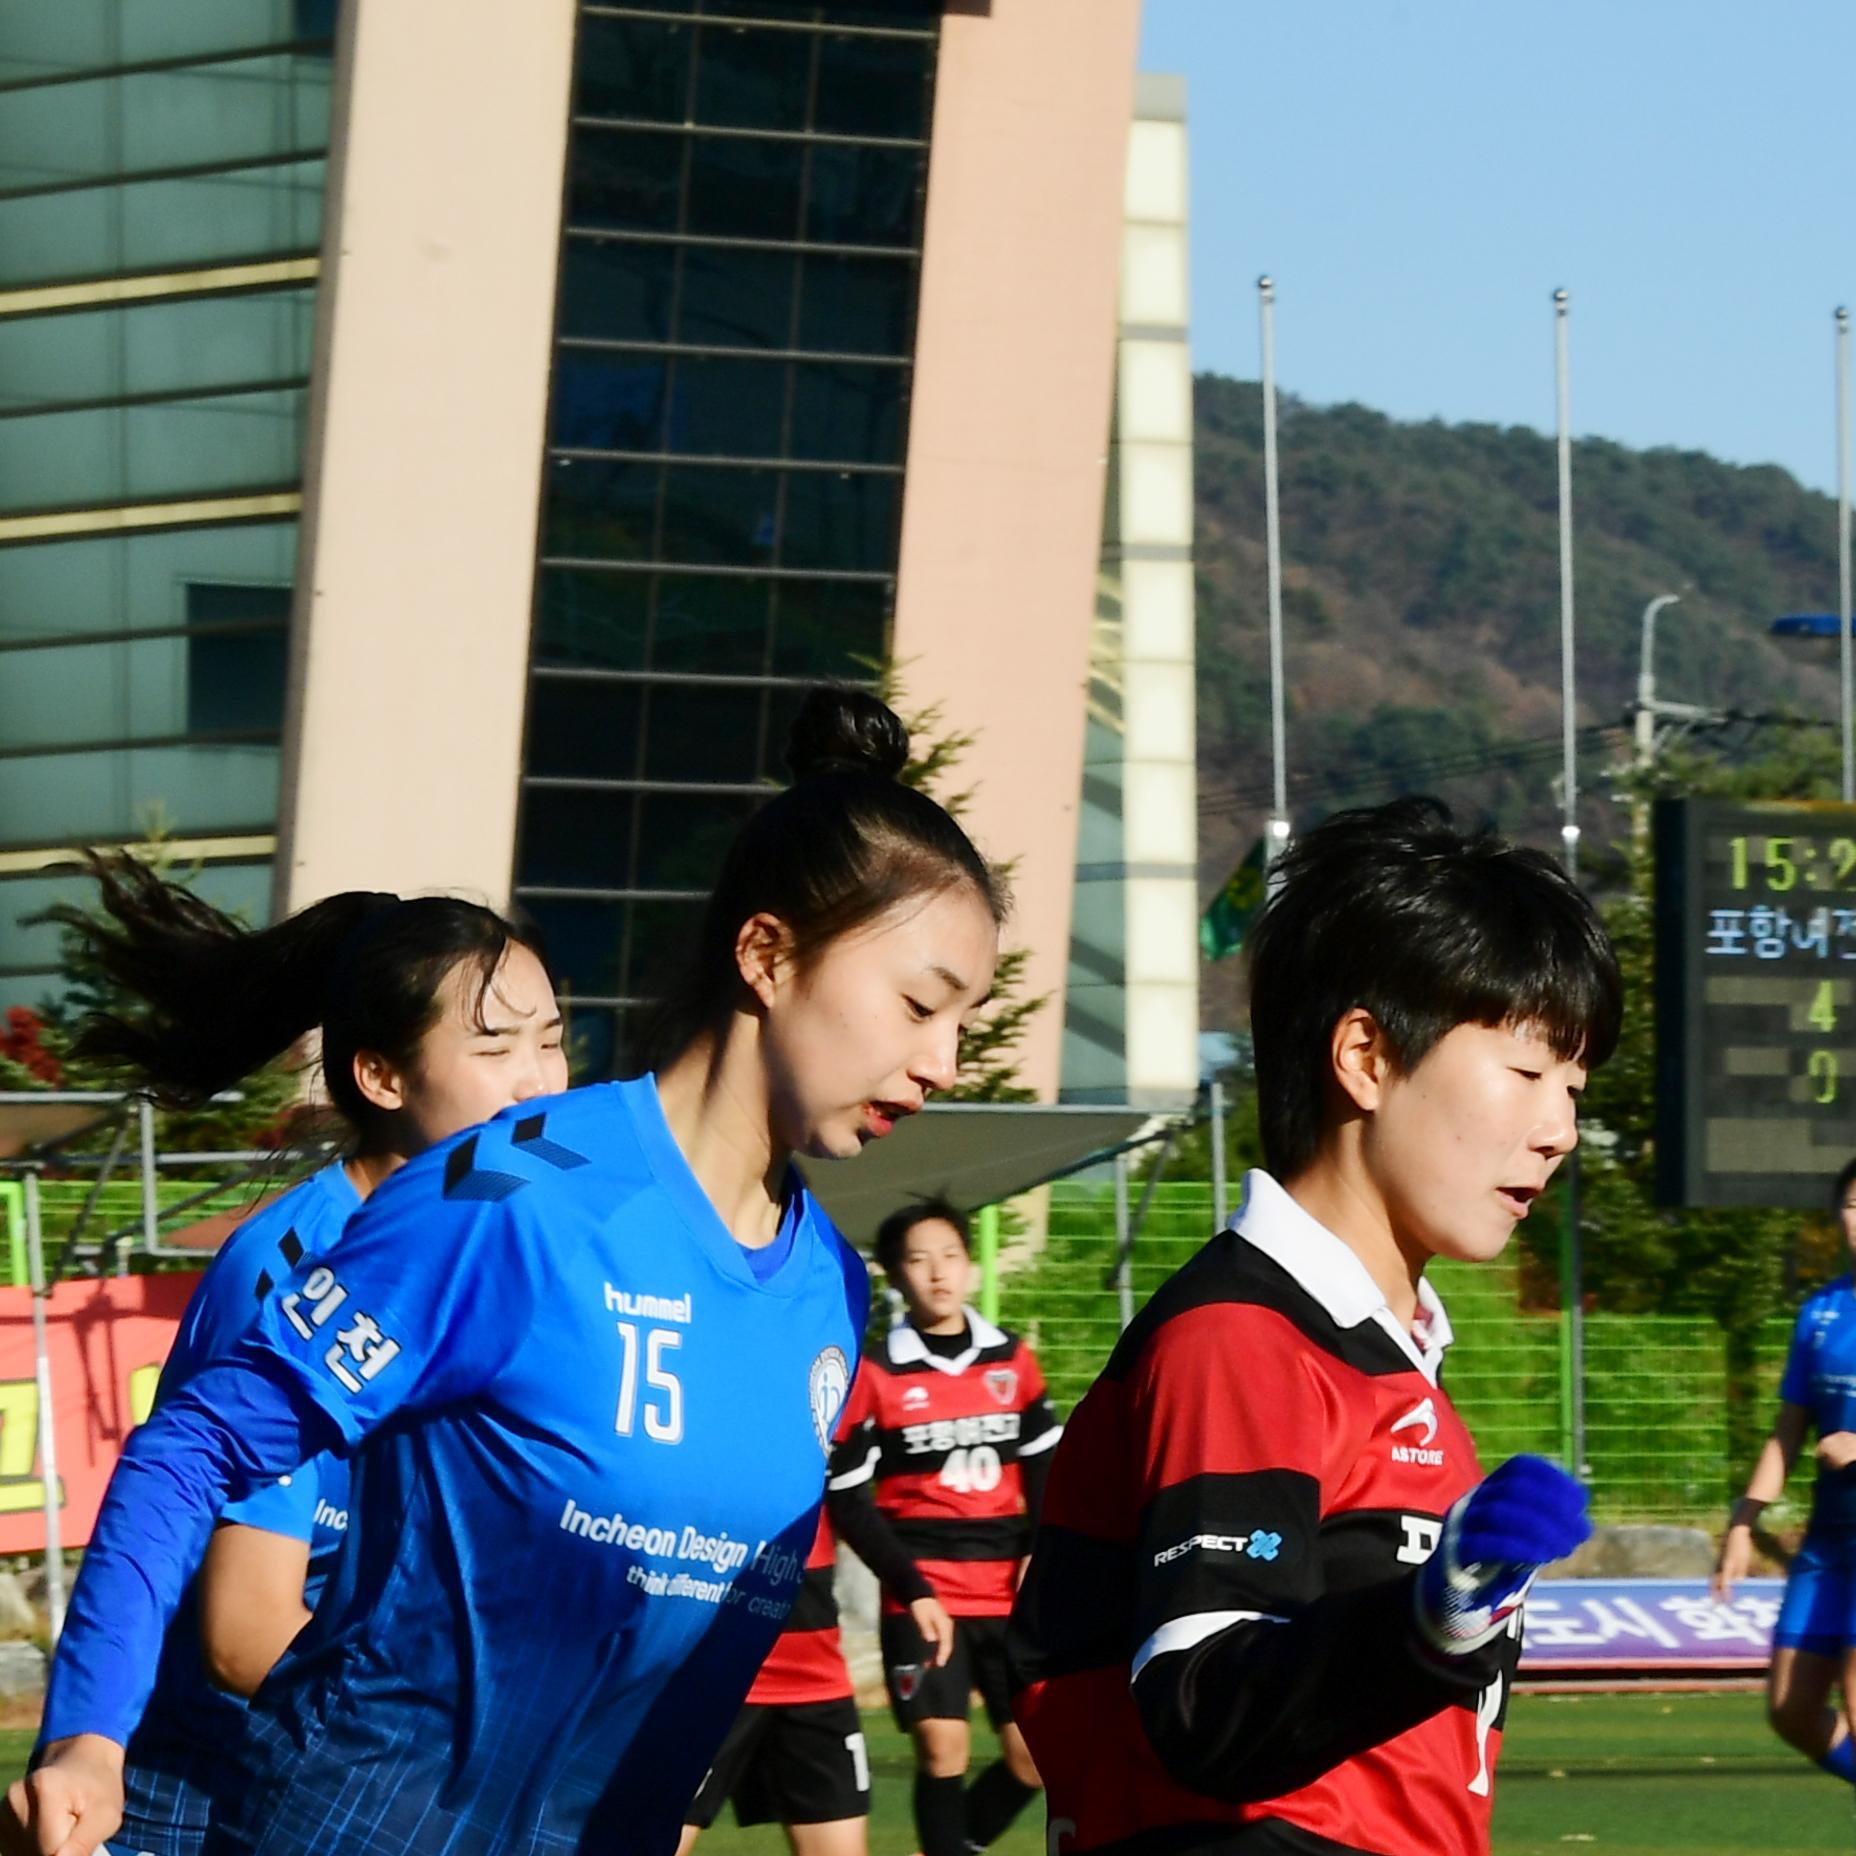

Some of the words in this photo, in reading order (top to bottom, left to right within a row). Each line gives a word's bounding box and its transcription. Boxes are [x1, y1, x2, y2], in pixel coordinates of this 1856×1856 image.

[1808, 980, 1837, 1033] 4
[604, 1281, 691, 1324] hummel
[281, 1266, 401, 1393] 인천
[614, 1321, 684, 1445] 15
[939, 1446, 1002, 1493] 40
[313, 1498, 348, 1531] Inc
[559, 1499, 677, 1558] Incheon
[678, 1526, 748, 1574] Design
[1154, 1534, 1248, 1567] RESPECT
[1522, 1597, 1681, 1649] 도시
